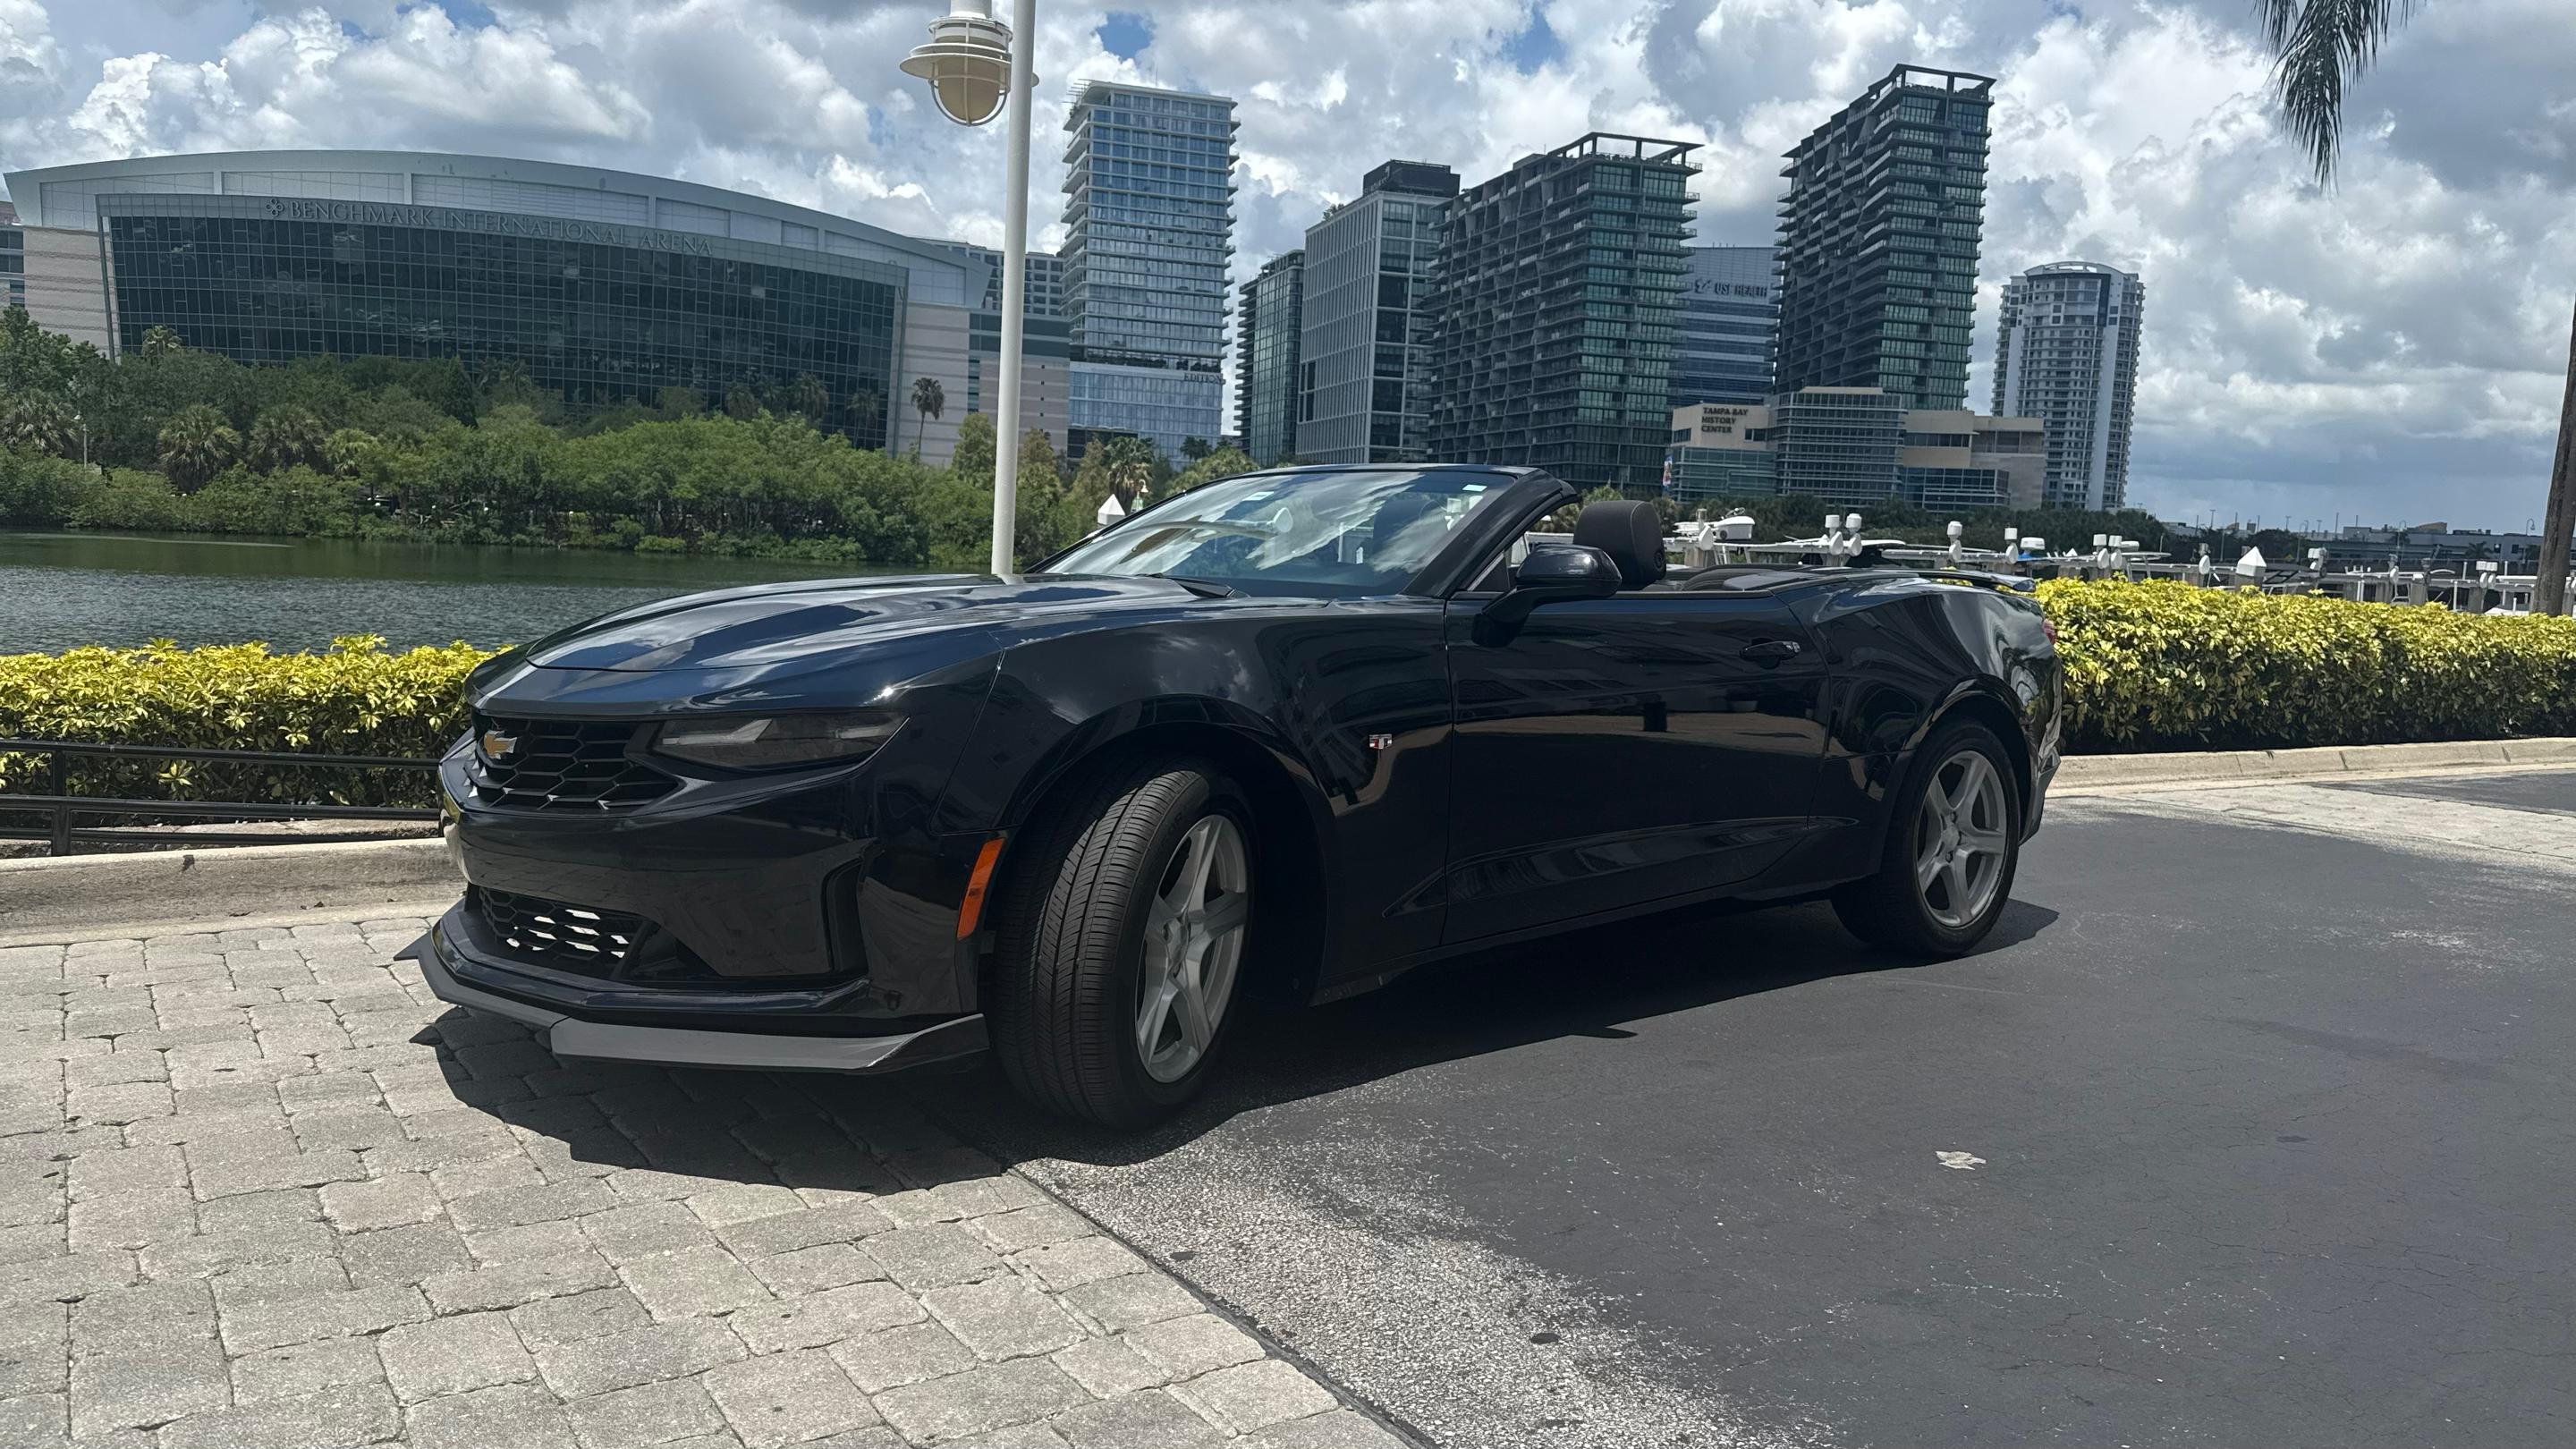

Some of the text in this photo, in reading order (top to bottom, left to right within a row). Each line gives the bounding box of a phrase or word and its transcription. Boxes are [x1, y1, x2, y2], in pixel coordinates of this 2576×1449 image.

[290, 200, 714, 256] BENCHMARK INTERNATIONAL ARENA
[1734, 284, 1768, 299] HEALTH
[1703, 407, 1749, 416] TAMPA BAY
[1701, 416, 1736, 425] HISTORY
[1701, 425, 1733, 434] CENTER
